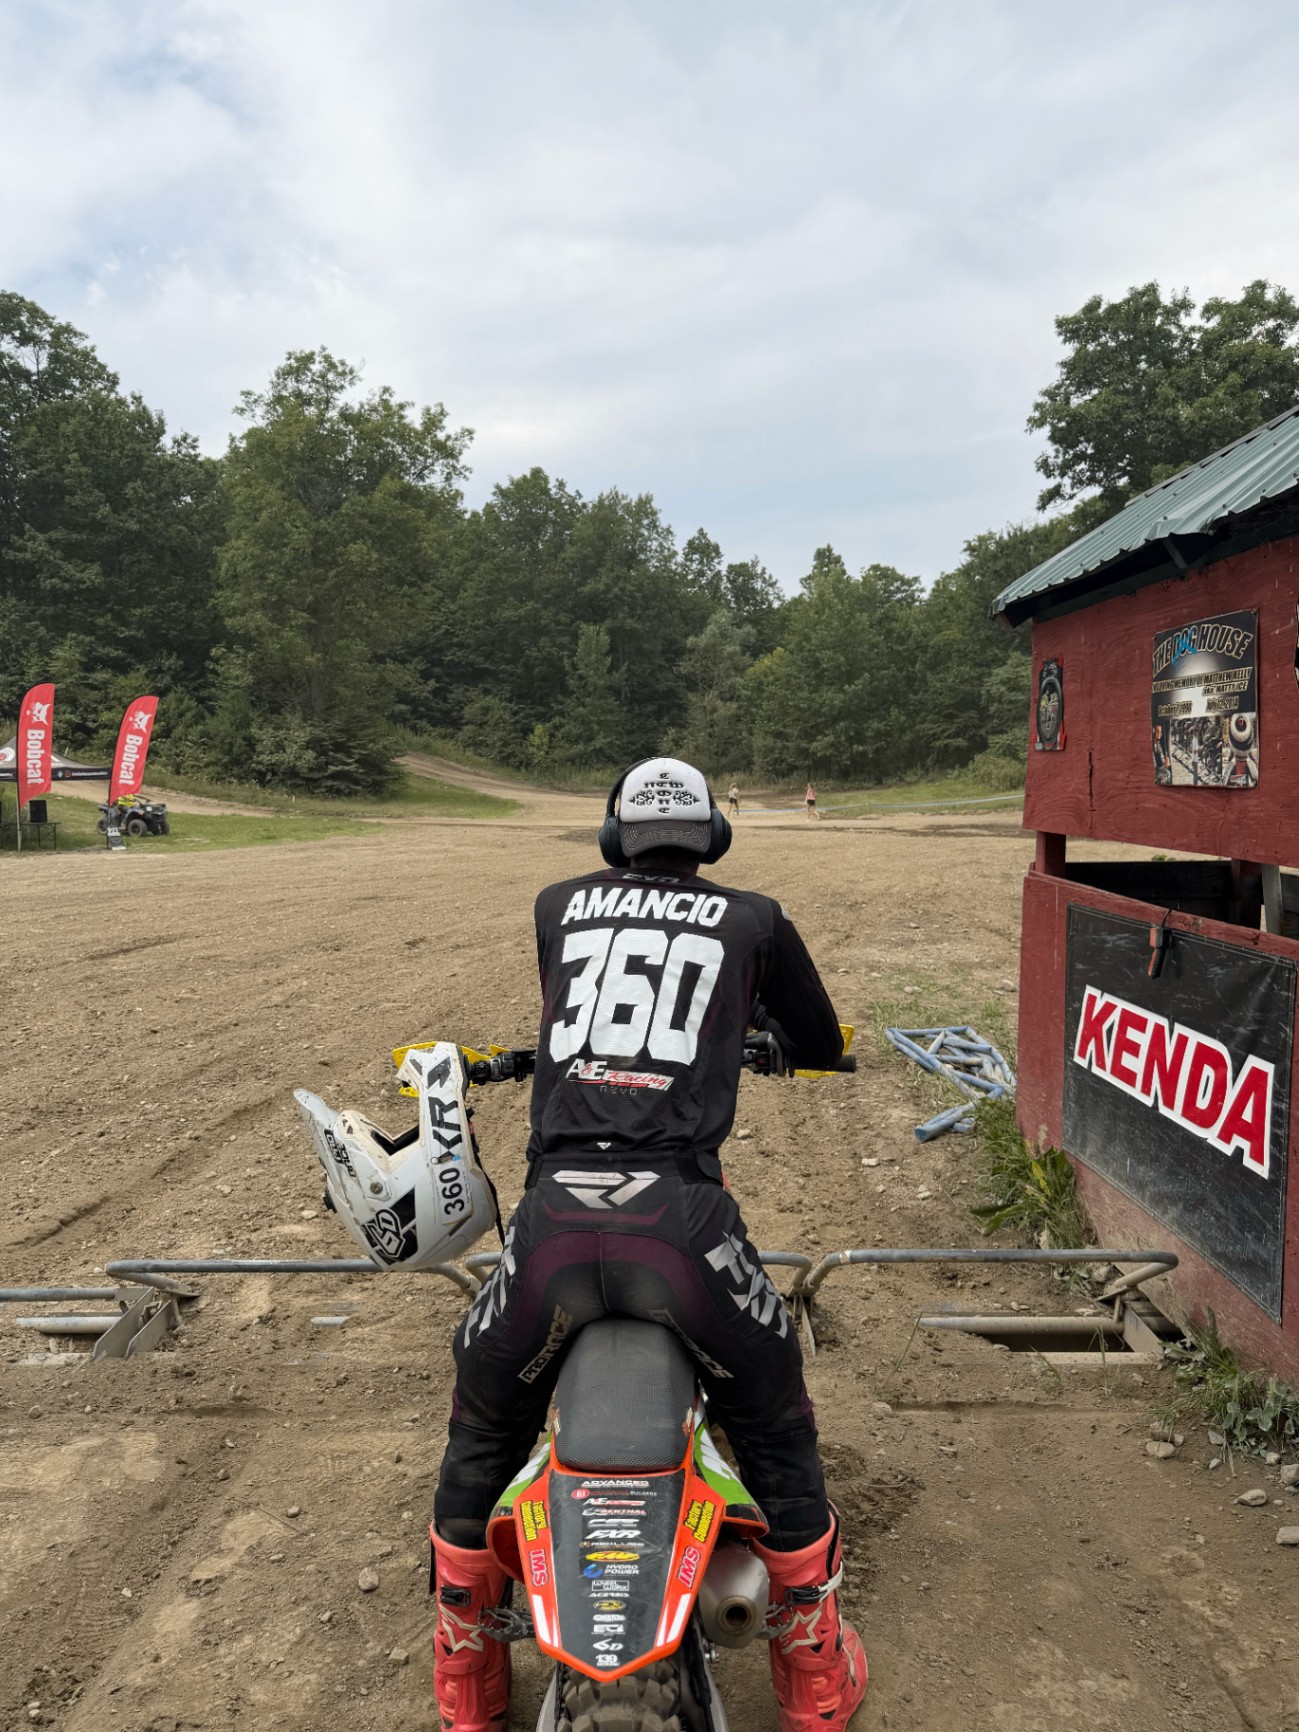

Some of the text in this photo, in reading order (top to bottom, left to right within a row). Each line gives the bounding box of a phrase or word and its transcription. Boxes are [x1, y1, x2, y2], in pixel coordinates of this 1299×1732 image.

[1153, 624, 1254, 678] THE DOG HOUSE
[27, 729, 45, 784] Bobcat
[118, 734, 143, 786] Bobcat
[561, 887, 728, 927] AMANCIO
[550, 928, 725, 1066] 360
[566, 1058, 668, 1088] A&E Racing
[1073, 984, 1275, 1180] KENDA
[439, 1167, 465, 1215] 360
[584, 1530, 641, 1539] FXR
[530, 1548, 548, 1586] IMS
[678, 1546, 700, 1588] IMS
[592, 1638, 624, 1651] 6D
